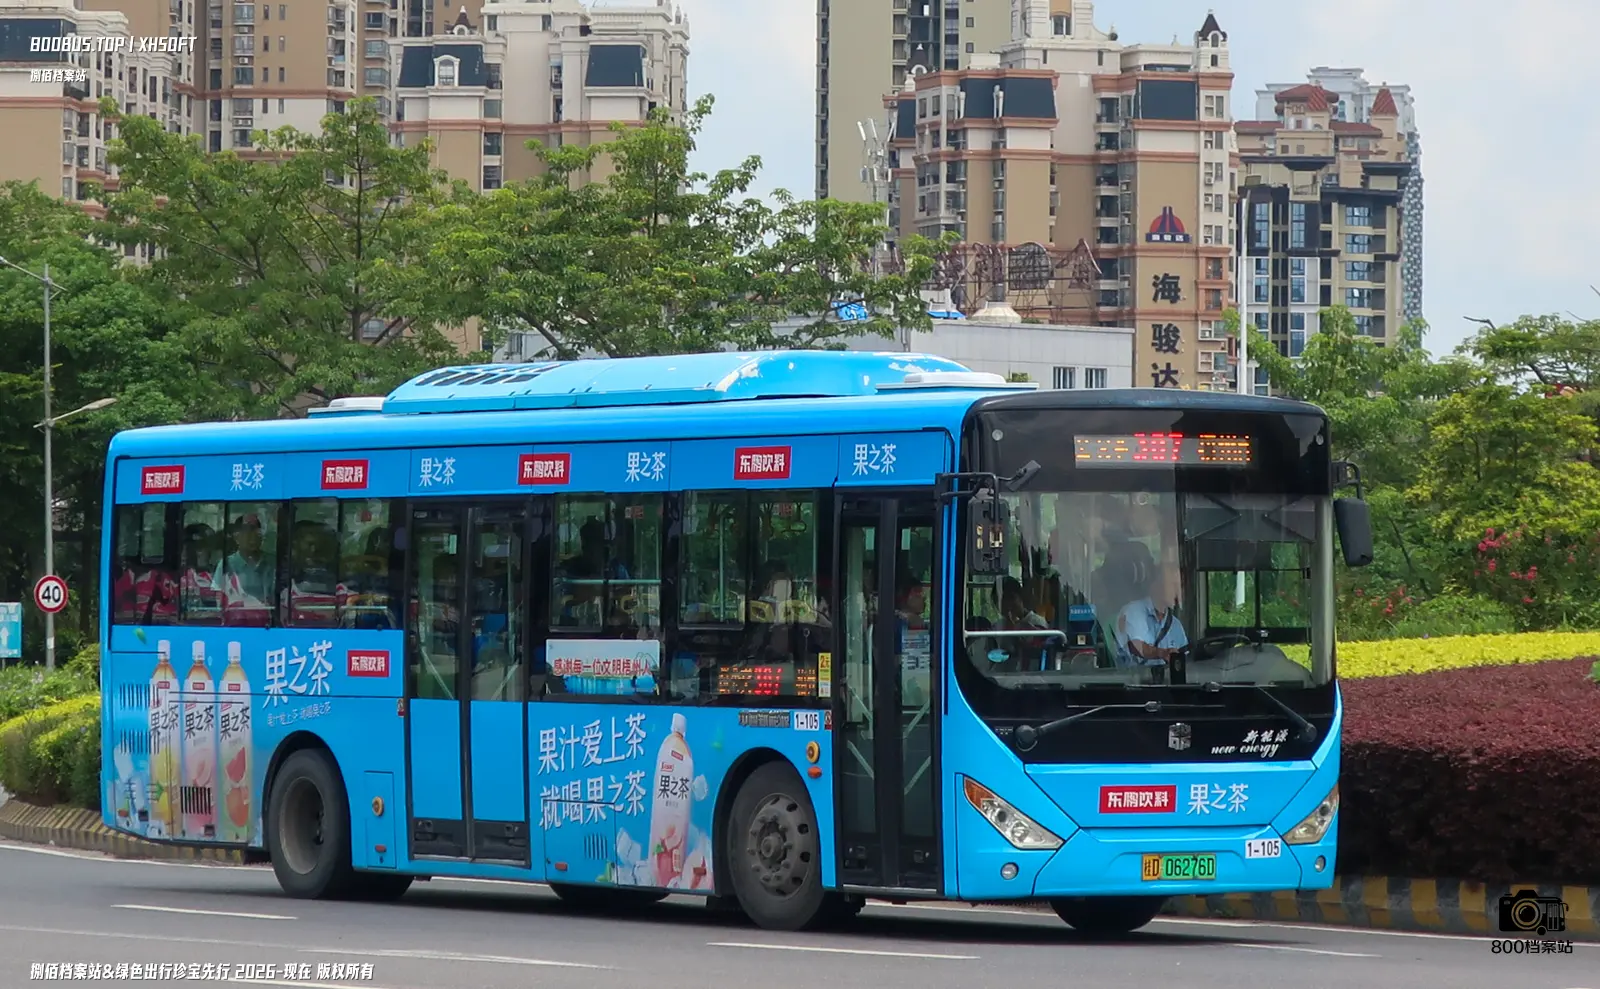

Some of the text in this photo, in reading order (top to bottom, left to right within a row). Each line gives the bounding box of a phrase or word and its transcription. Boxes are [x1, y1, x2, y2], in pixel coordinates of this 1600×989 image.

[1152, 273, 1181, 388] 海骏达
[418, 457, 456, 487] 果之茶
[523, 460, 564, 478] 东鹏饮料
[624, 451, 666, 482] 果之茶
[740, 453, 785, 473] 东鹏饮料
[852, 443, 897, 476] 果之茶
[145, 472, 180, 489] 东鹏饮料
[230, 463, 265, 490] 果之茶
[325, 466, 363, 484] 东鹏饮料
[41, 586, 61, 603] 40
[262, 640, 333, 708] 果之茶
[553, 657, 652, 676] 感谢每一位文明梧州人
[150, 704, 179, 738] 果之茶
[184, 705, 214, 740] 果之茶
[220, 707, 250, 742] 果之茶
[795, 714, 818, 729] 1-105
[538, 712, 646, 775] 果汁爱上茶
[1240, 743, 1279, 758] energy
[539, 769, 646, 830] 就喝果之茶
[658, 775, 690, 799] 果之茶
[1107, 791, 1168, 808] 东鹏饮料
[1187, 783, 1248, 815] 果之茶
[1247, 840, 1280, 857] 1-105
